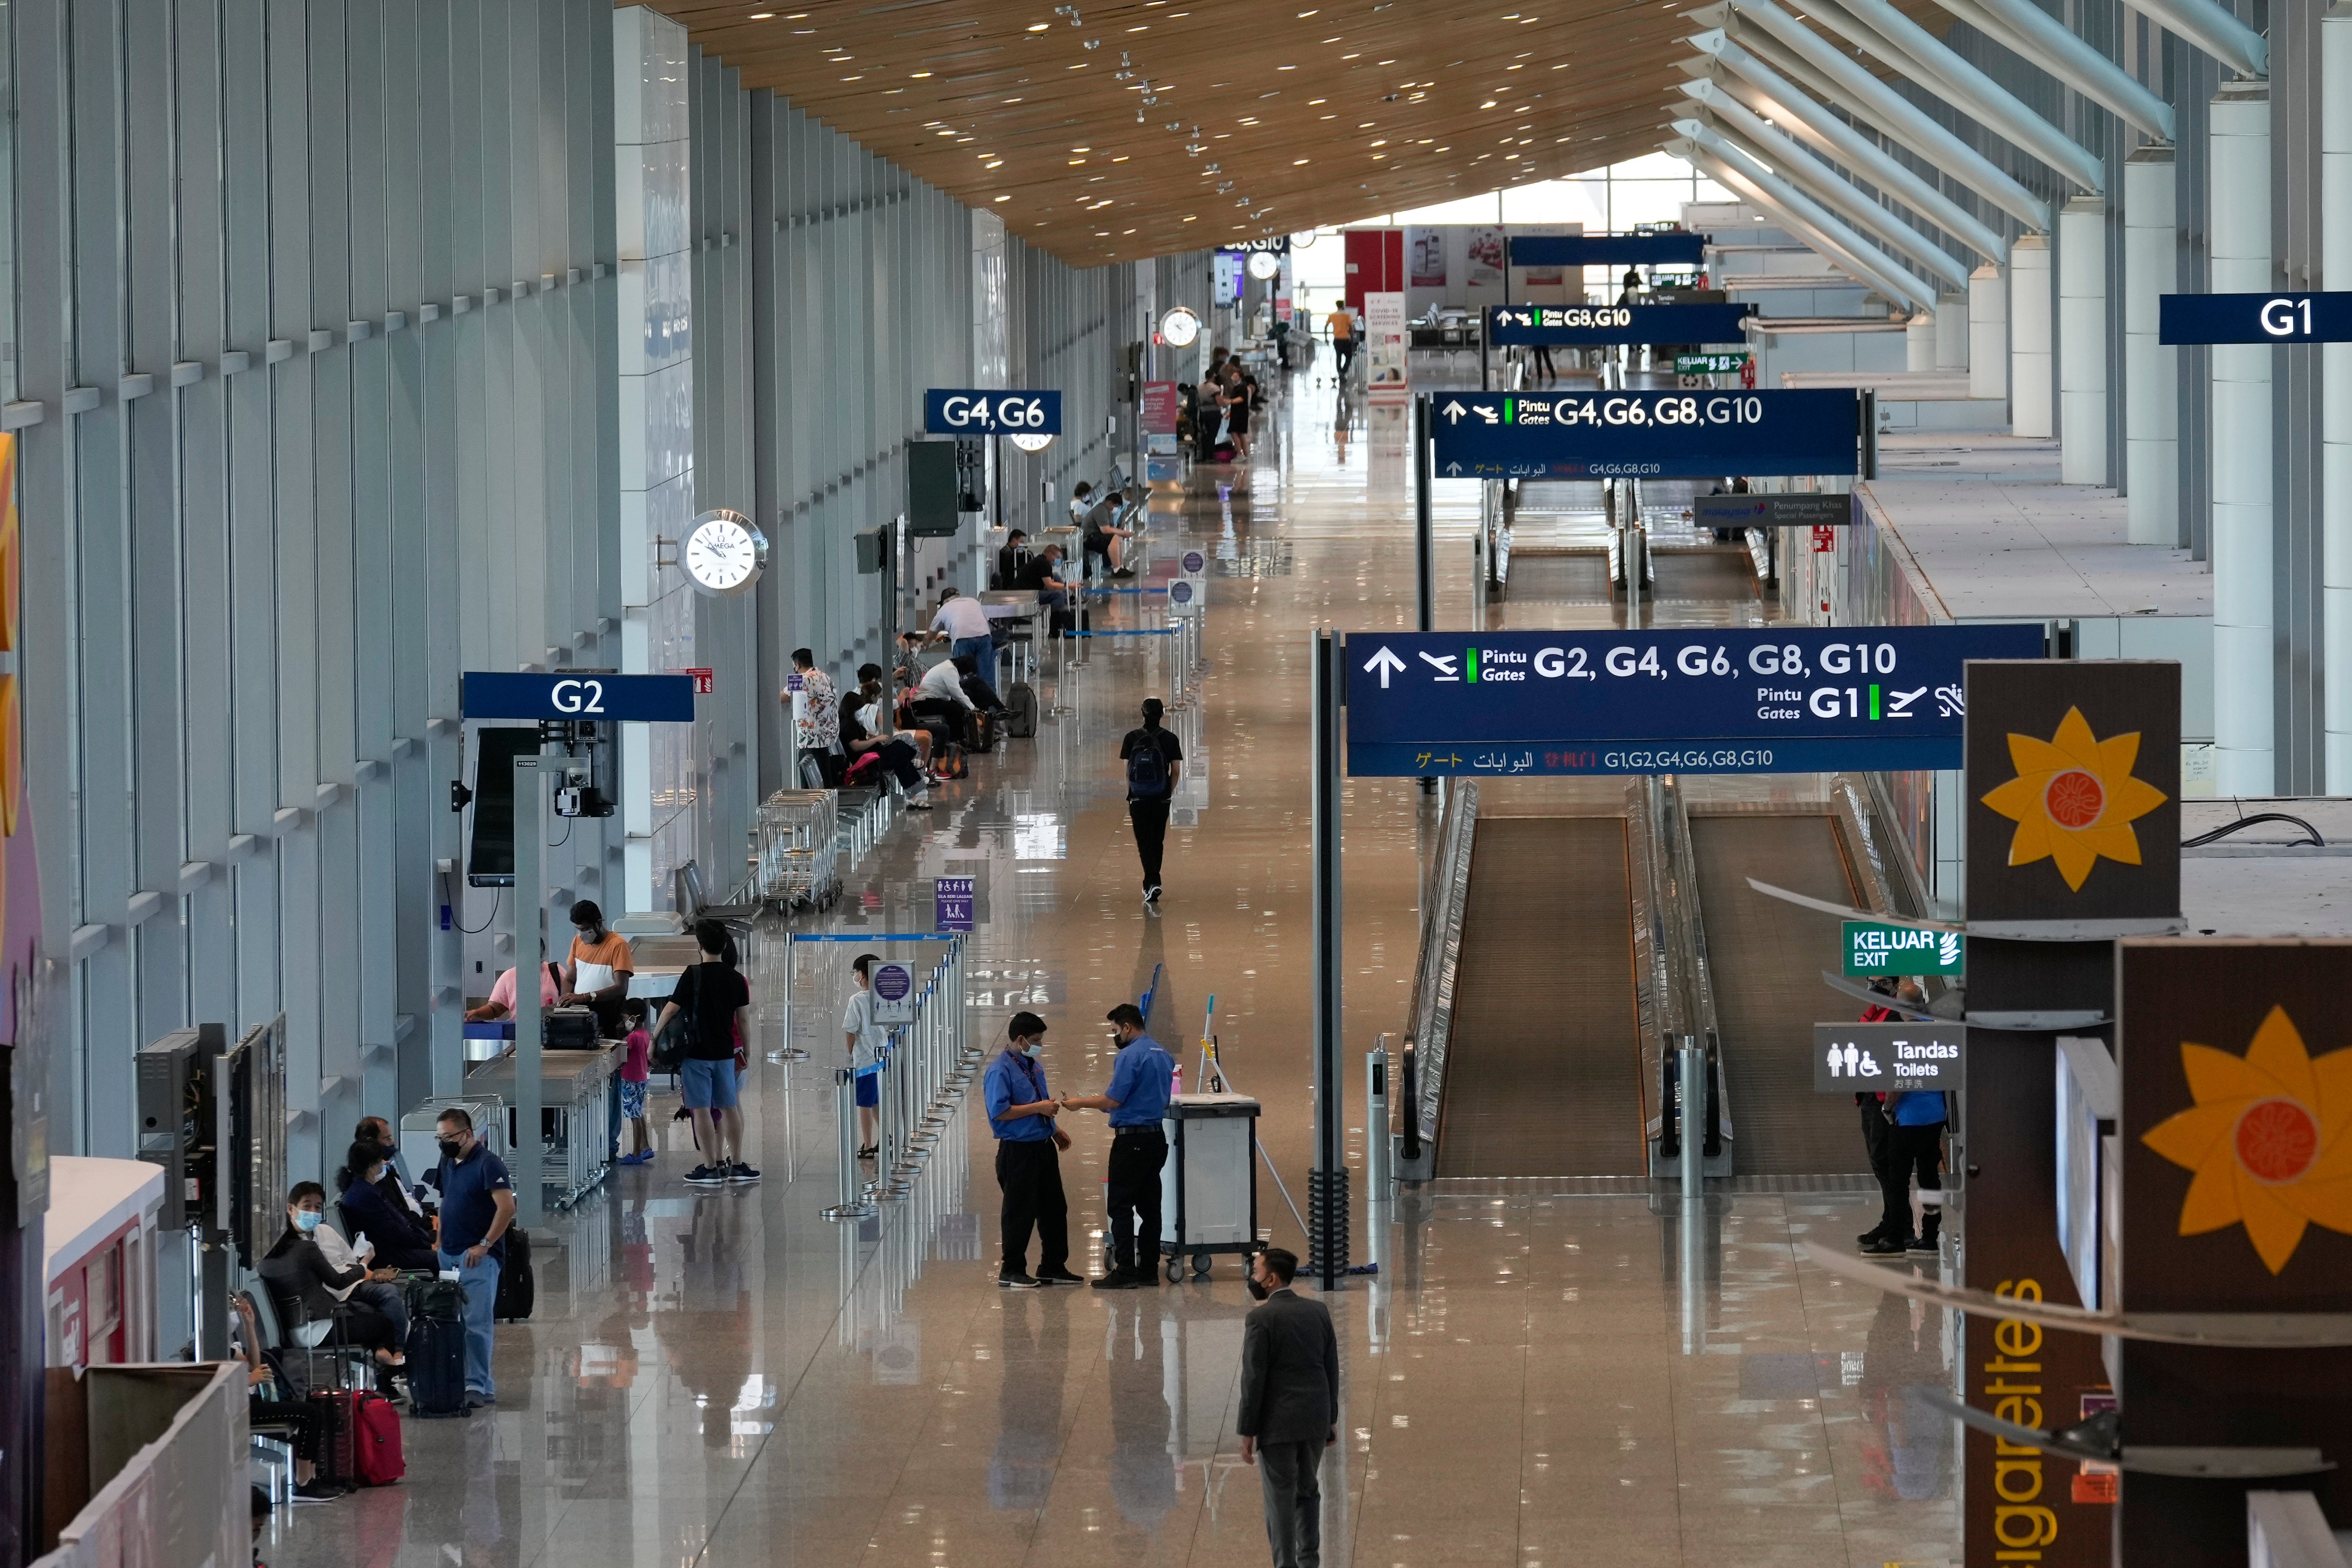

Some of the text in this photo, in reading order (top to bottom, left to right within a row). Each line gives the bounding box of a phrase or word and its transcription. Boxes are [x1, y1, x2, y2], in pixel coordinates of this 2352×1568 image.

[1542, 308, 1631, 329] Pintu G8,G10
[1542, 319, 1563, 327] Gates
[2261, 299, 2311, 336] G1
[1677, 356, 1708, 365] KELUAR
[1518, 399, 1550, 412] Pintu
[943, 397, 1044, 431] G4,G6
[1518, 414, 1550, 425] Gates
[1590, 463, 1660, 475] G4,G6,G8,G10
[1774, 502, 1820, 510] Penumpang
[1483, 643, 1896, 681] Pintu G2, G4, G6, G8, G10
[1482, 668, 1525, 681] Gates
[551, 680, 604, 713] G2
[1758, 687, 1858, 718] Pintu G1
[1757, 706, 1800, 719] Gates
[1416, 752, 1463, 768] ゲート
[1604, 750, 1773, 769] G1,G2,G4,G6,G8,G10
[1854, 931, 1934, 949] KELUAR
[1854, 952, 1889, 966] EXIT
[1893, 1041, 1958, 1059] Tandas
[1893, 1063, 1938, 1076] Toilets
